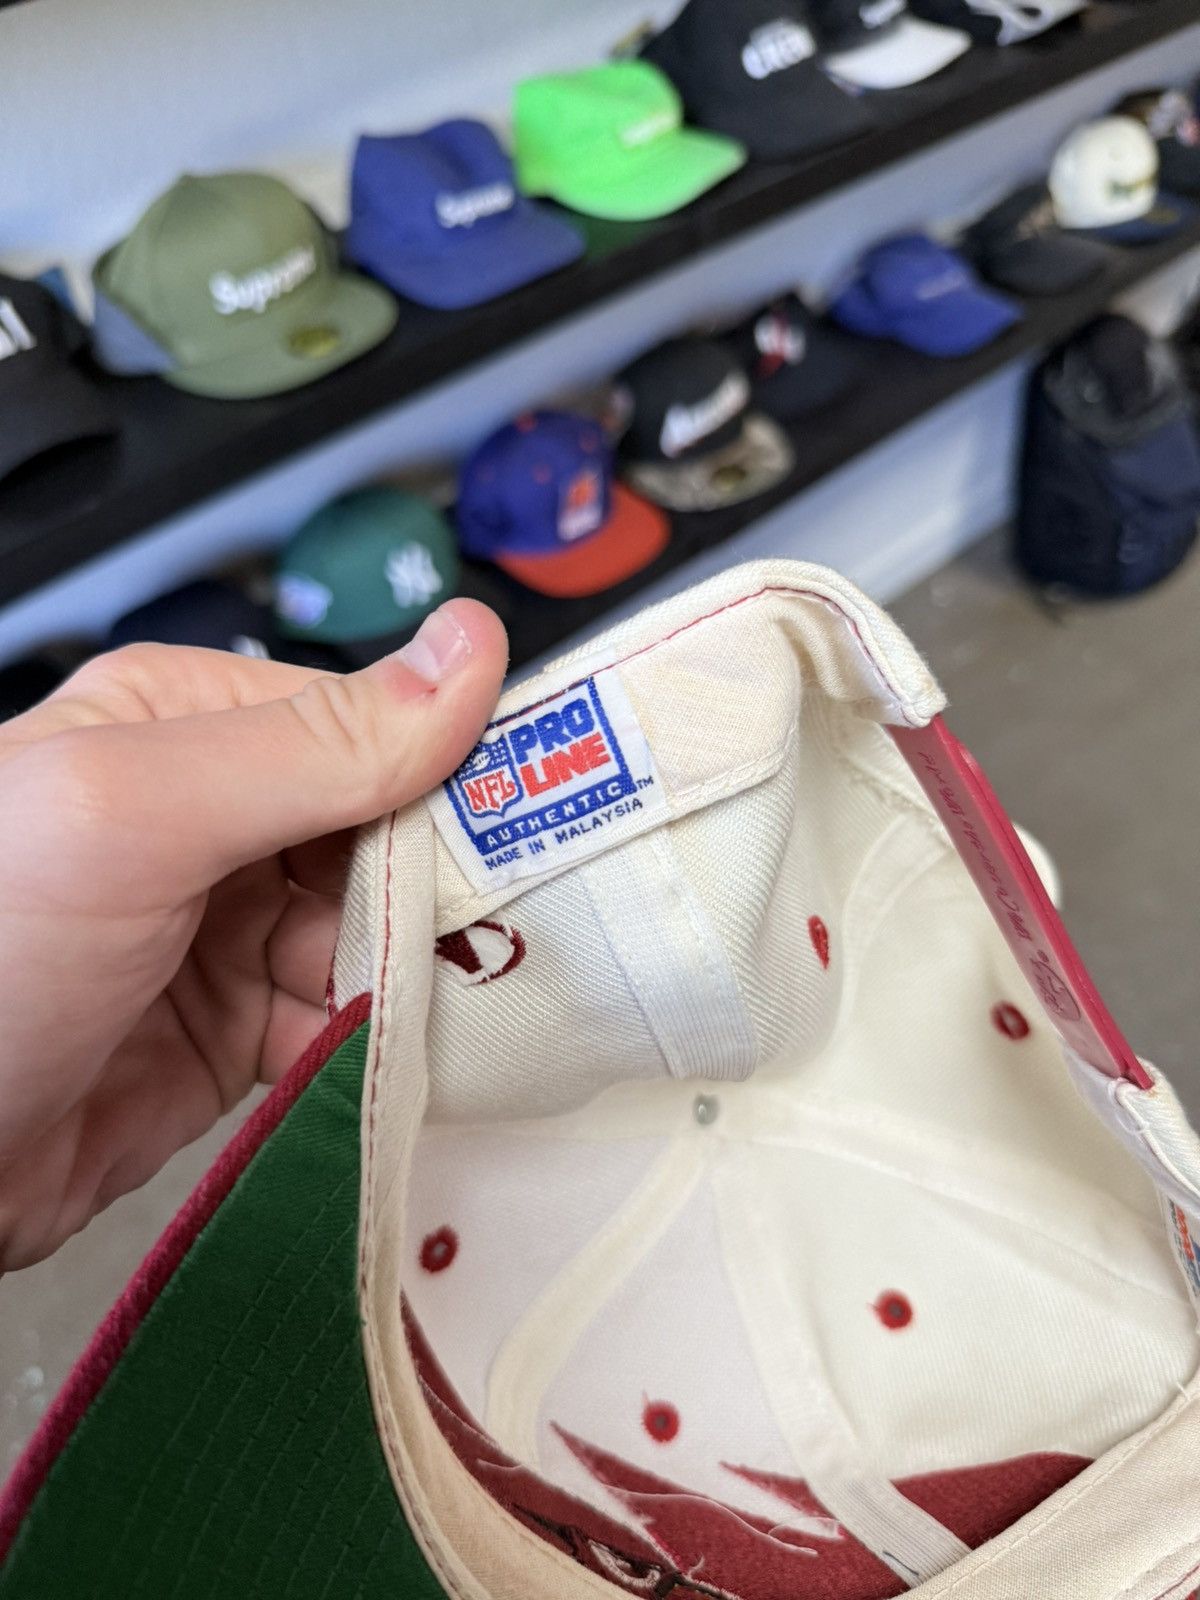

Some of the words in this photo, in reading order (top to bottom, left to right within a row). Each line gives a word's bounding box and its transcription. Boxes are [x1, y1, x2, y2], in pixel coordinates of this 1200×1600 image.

[507, 697, 595, 764] PRO
[463, 770, 516, 812] NFL
[519, 731, 611, 798] LINE
[484, 847, 523, 871] MADE
[528, 838, 546, 854] IN
[554, 798, 643, 844] MALAYSIA
[486, 781, 623, 848] AUTHENTIC
